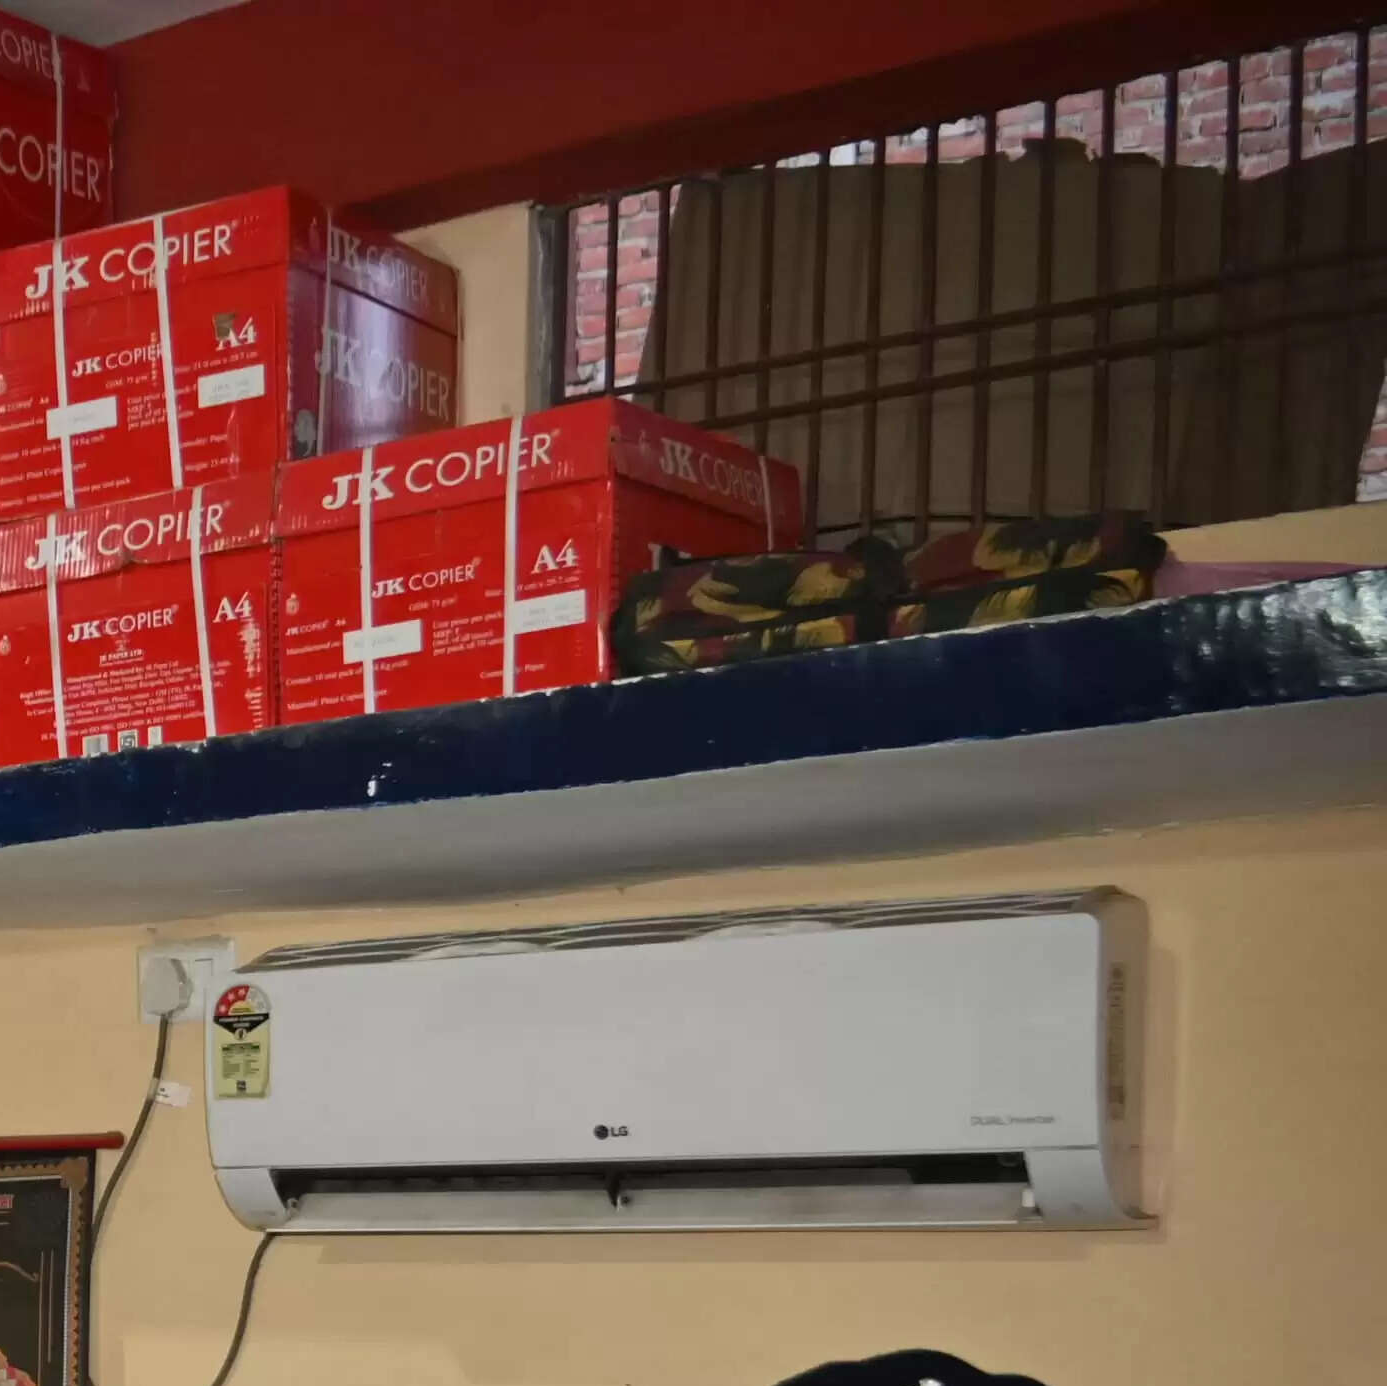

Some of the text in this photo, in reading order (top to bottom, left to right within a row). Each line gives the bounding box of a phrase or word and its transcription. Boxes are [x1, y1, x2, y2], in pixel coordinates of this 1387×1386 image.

[25, 224, 233, 300] JK COPIER
[215, 316, 258, 351] A4
[71, 356, 103, 378] JK
[321, 432, 553, 511] JK COPIER
[660, 437, 699, 484] JK
[25, 530, 88, 571] JK
[530, 537, 578, 575] A4
[372, 562, 476, 599] JK COPIER
[67, 606, 175, 643] JK COPIER
[212, 591, 253, 624] A4
[610, 1125, 629, 1137] LG
